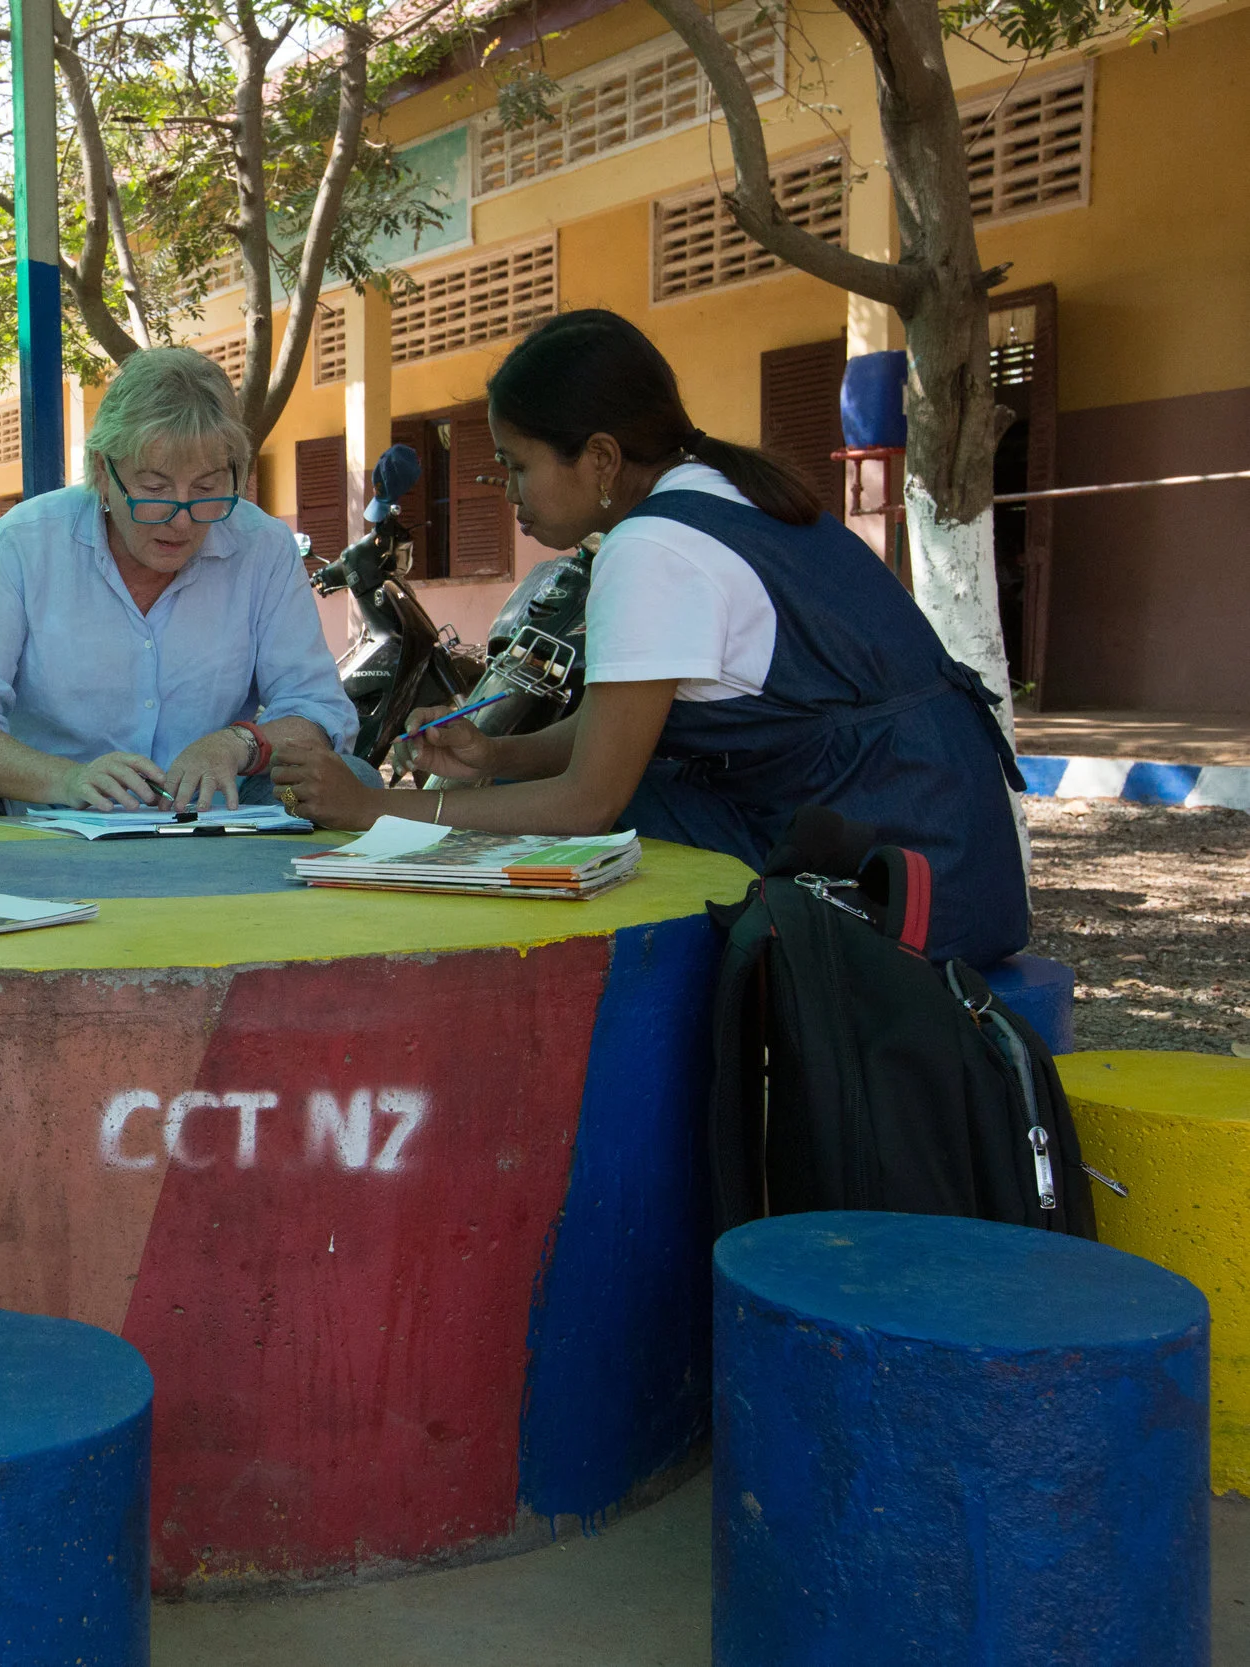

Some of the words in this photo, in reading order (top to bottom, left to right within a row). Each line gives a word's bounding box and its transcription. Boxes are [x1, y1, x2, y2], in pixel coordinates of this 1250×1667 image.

[352, 670, 391, 678] HONDA
[98, 1088, 279, 1170] CCT
[305, 1086, 432, 1172] N7
